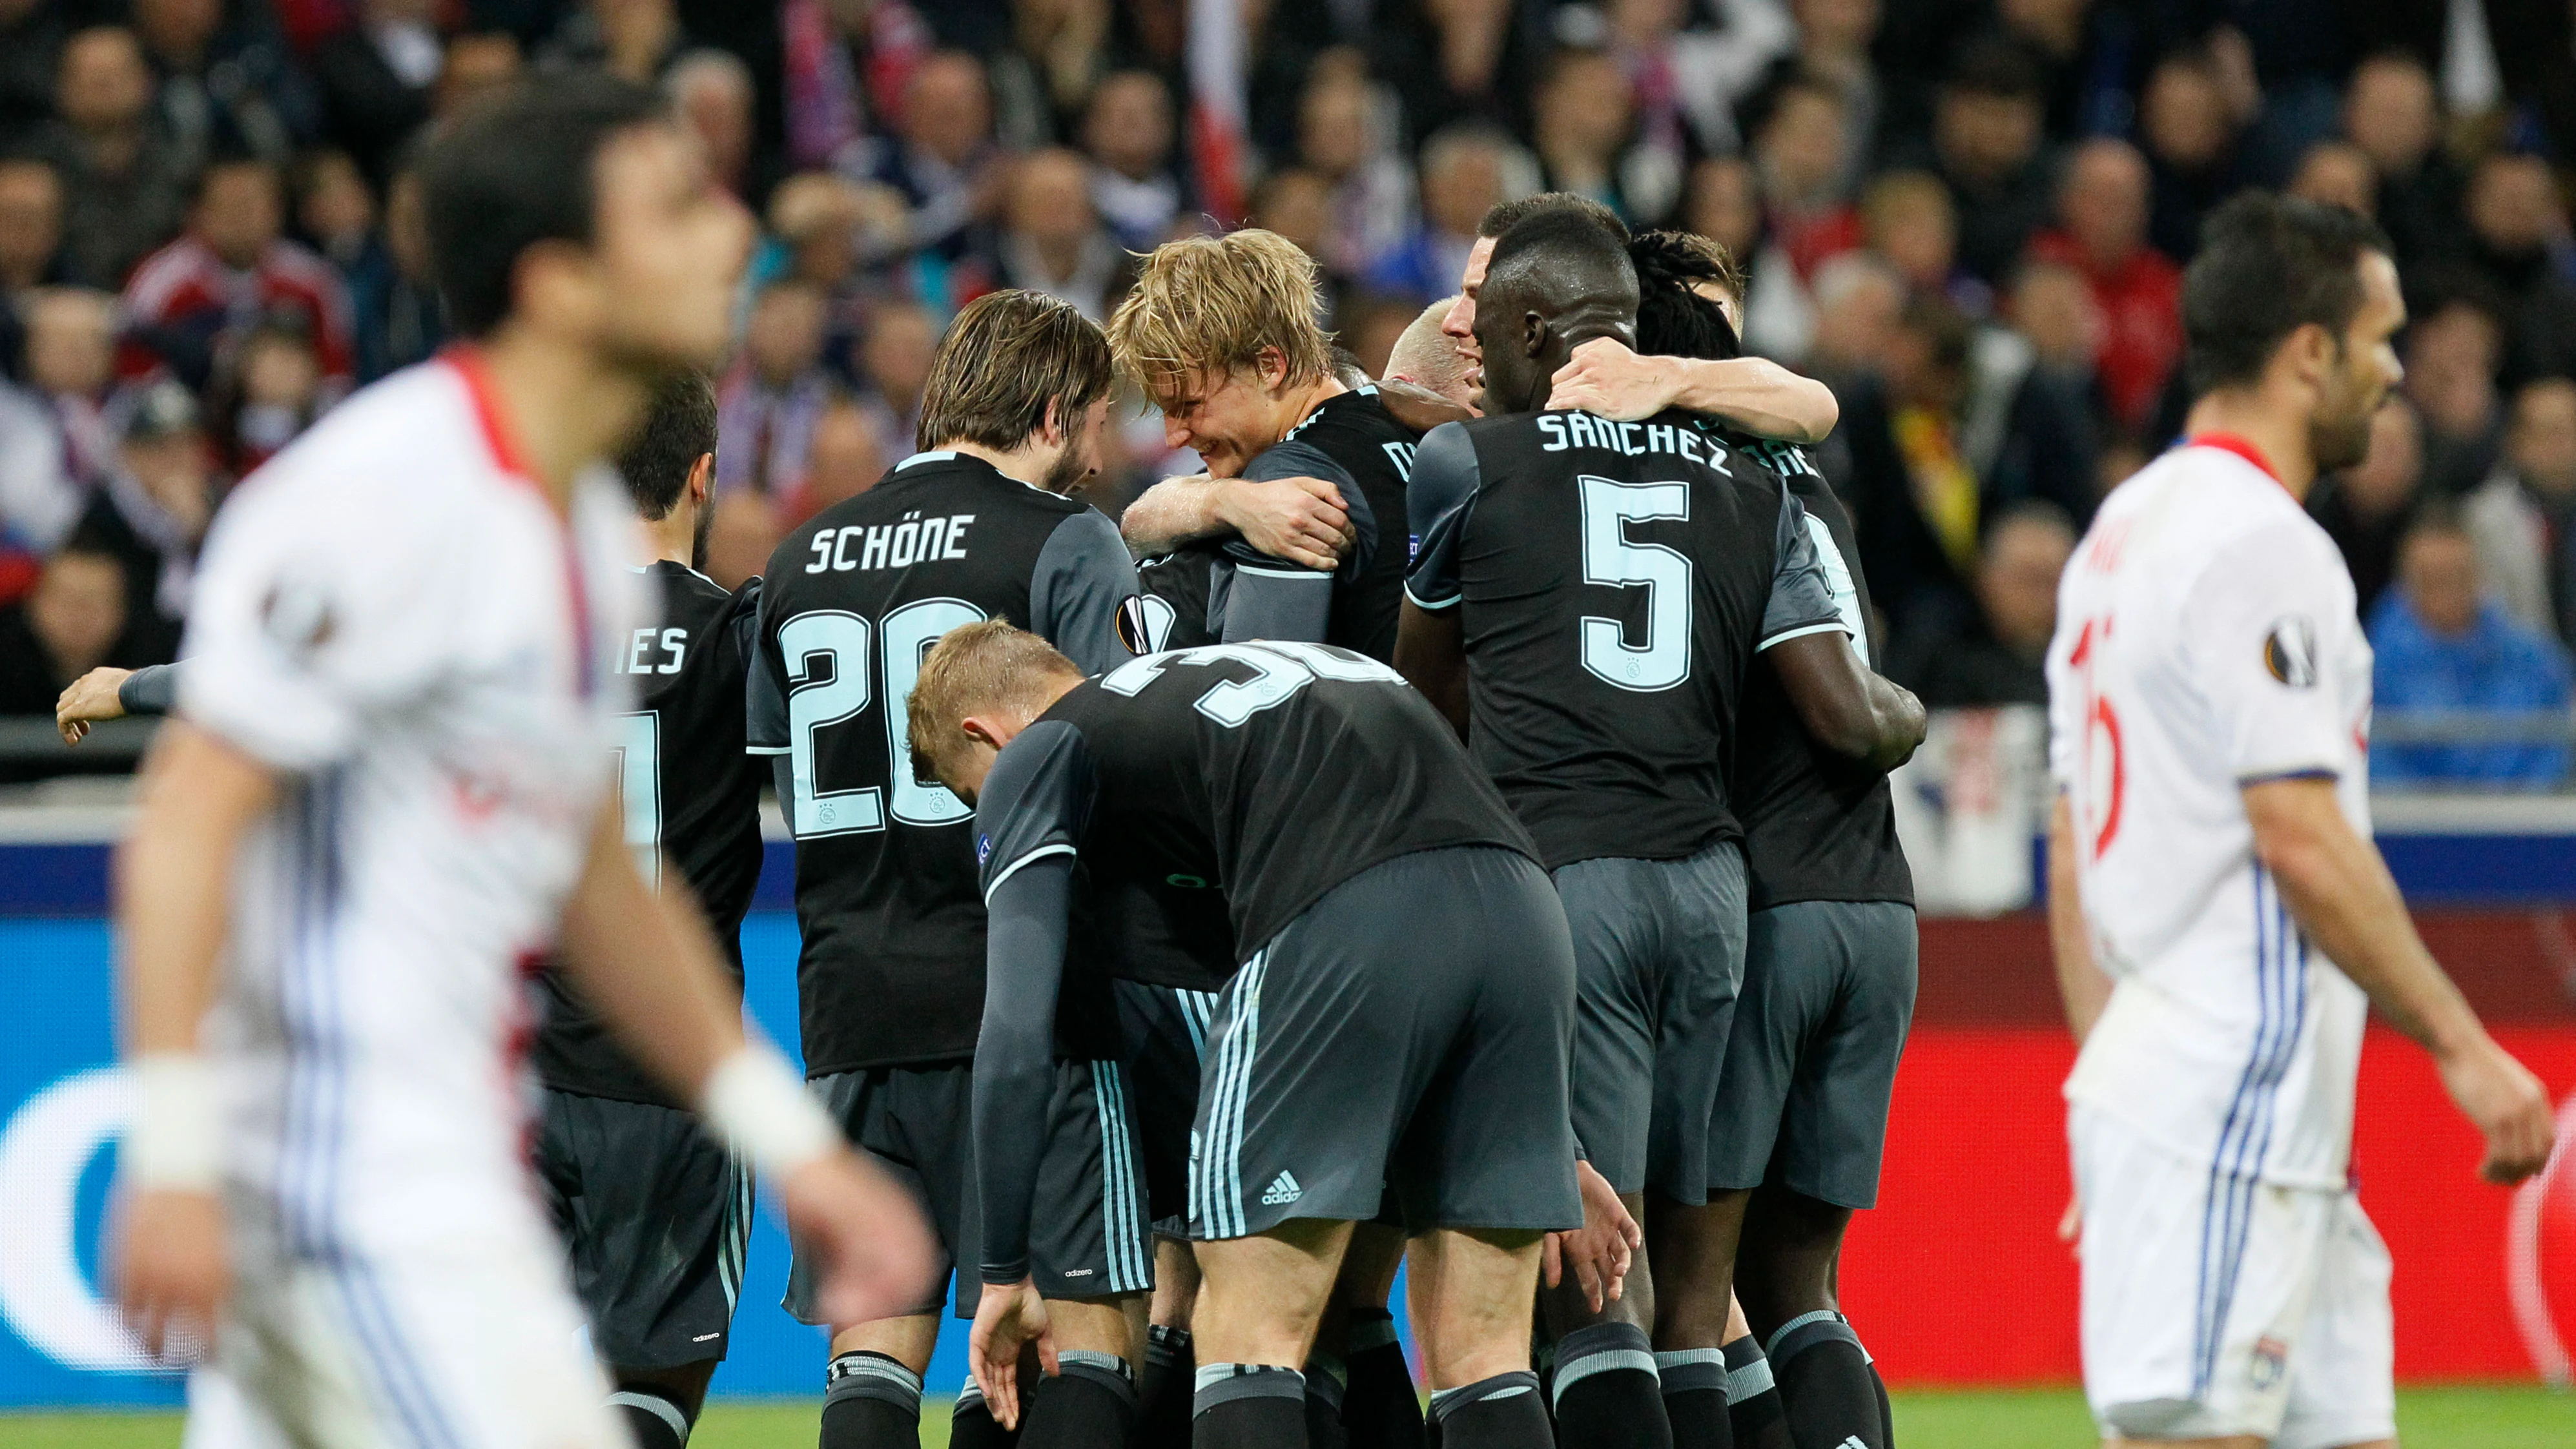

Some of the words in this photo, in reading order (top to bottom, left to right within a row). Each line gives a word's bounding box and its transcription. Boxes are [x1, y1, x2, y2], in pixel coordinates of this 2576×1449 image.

[805, 510, 976, 574] SCHÖNE
[1577, 475, 1693, 692] 5
[1065, 1268, 1093, 1277] adizero
[692, 1332, 720, 1342] adizero
